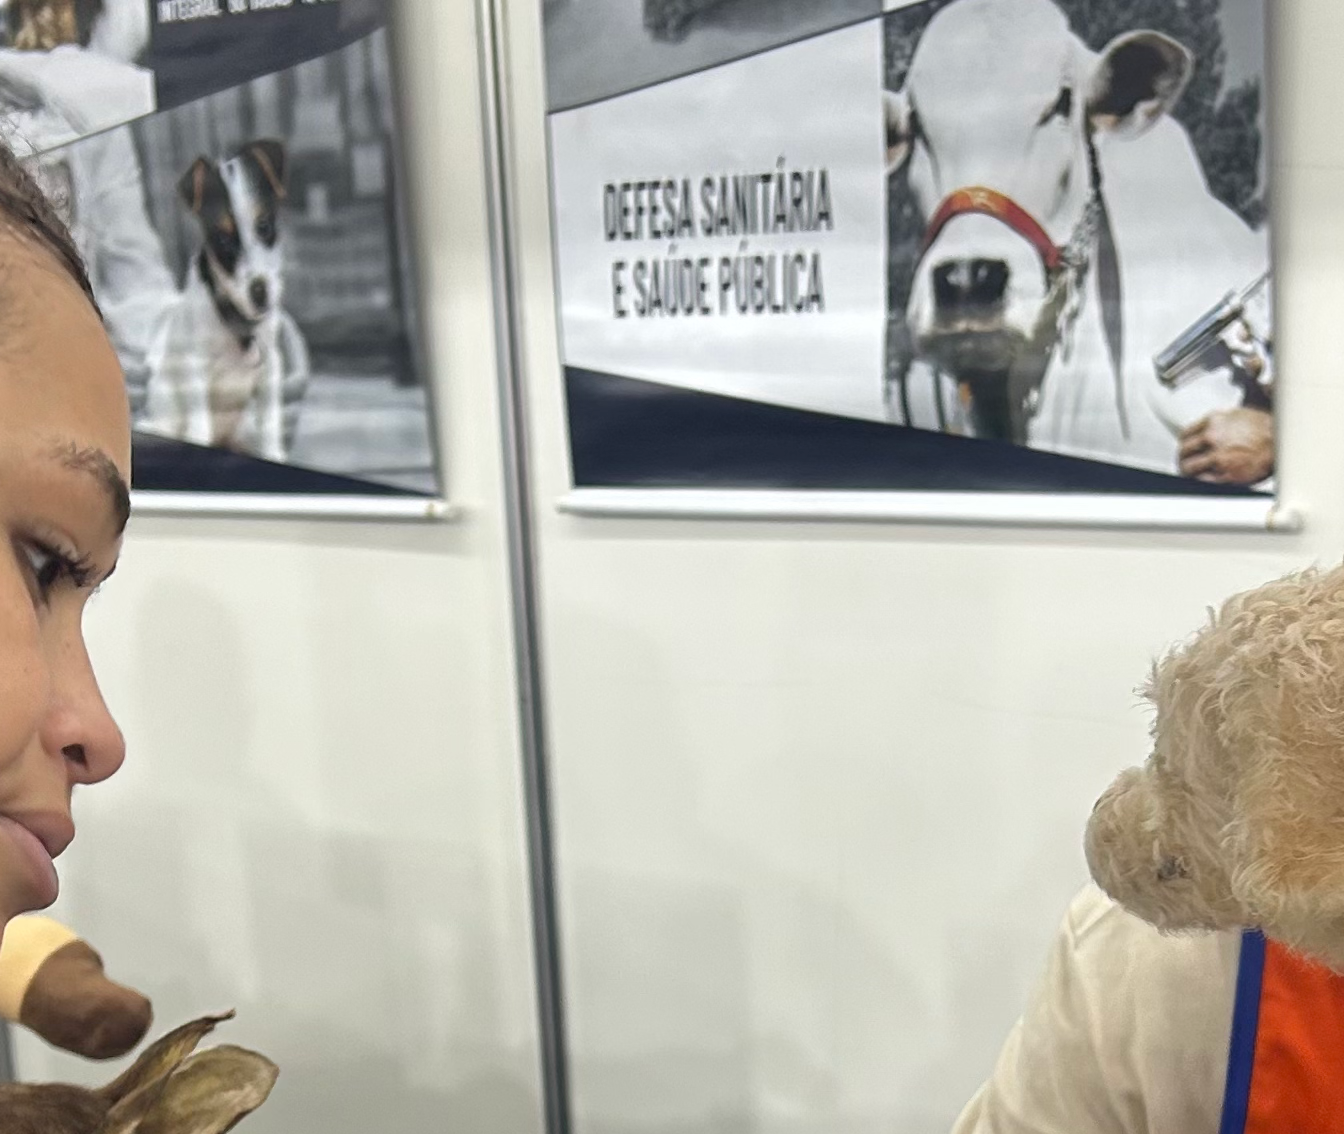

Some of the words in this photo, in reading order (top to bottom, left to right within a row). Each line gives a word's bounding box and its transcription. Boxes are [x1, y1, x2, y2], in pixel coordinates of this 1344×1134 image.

[604, 178, 697, 242] DEFESA
[700, 154, 834, 236] SANITÁRIA
[612, 261, 628, 319] E
[632, 242, 712, 318] SAÚDE
[718, 237, 826, 316] PÚBLICA
